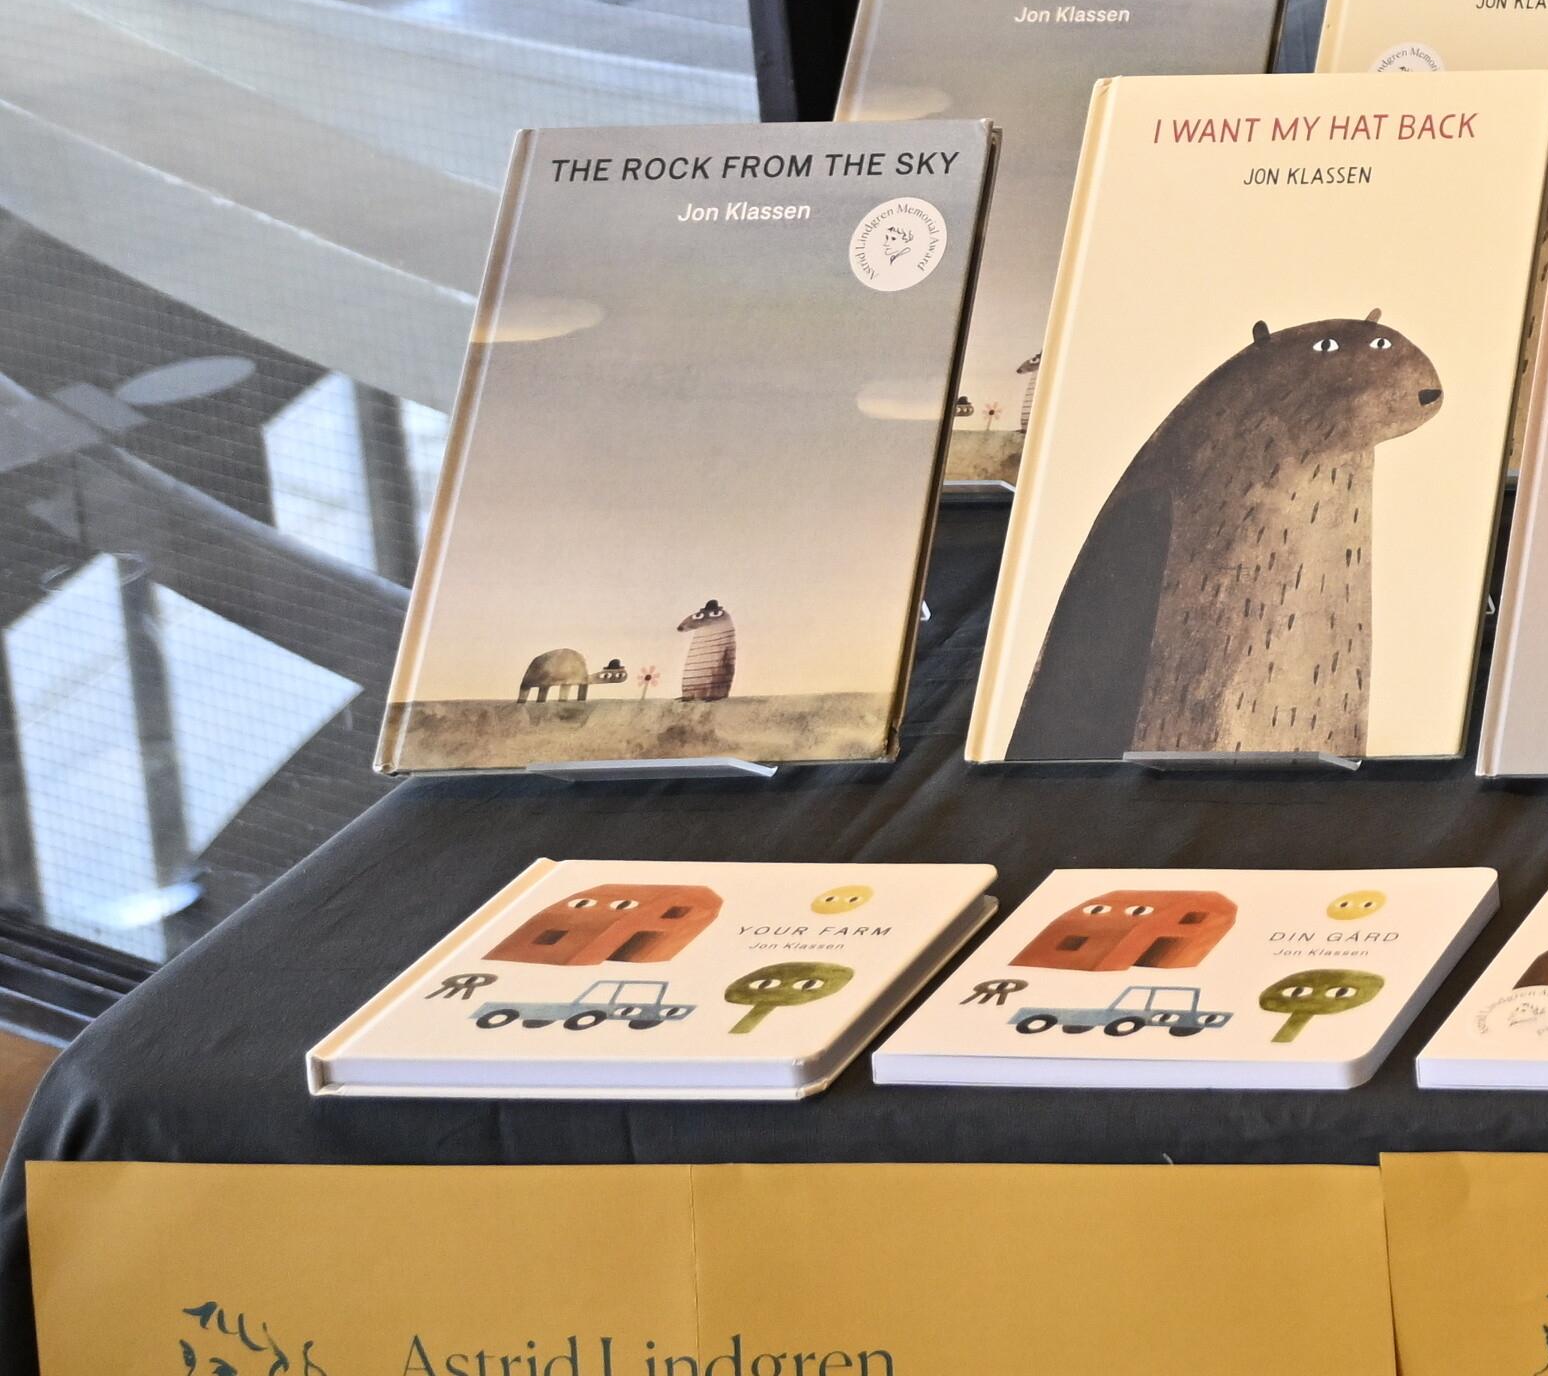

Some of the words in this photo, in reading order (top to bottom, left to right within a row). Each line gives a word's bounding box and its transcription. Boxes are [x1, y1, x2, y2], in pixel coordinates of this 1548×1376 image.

[1014, 6, 1050, 23] Jon
[1055, 5, 1130, 23] Klassen
[1153, 118, 1162, 144] I
[1172, 117, 1261, 144] WANT
[1271, 115, 1321, 142] MY
[1329, 114, 1389, 141] HAT
[1397, 112, 1478, 141] BACK
[551, 158, 613, 183] THE
[621, 156, 713, 182] ROCK
[721, 154, 813, 179] FROM
[825, 152, 886, 177] THE
[895, 151, 960, 176] SKY
[1243, 167, 1280, 186] JON
[1286, 166, 1372, 185] KLASSEN
[677, 203, 719, 222] Jon
[725, 201, 811, 221] Klassen
[897, 203, 940, 235] Memorial
[857, 208, 894, 246] Lindgren
[855, 246, 878, 280] Astrid
[917, 237, 939, 271] Award
[739, 926, 809, 936] YOUR
[818, 926, 892, 936] FARM
[1269, 931, 1316, 942] DIN
[748, 942, 778, 950] Jon
[782, 942, 845, 950] Klassen
[1273, 948, 1302, 956] Jon
[1307, 948, 1369, 957] Klassen
